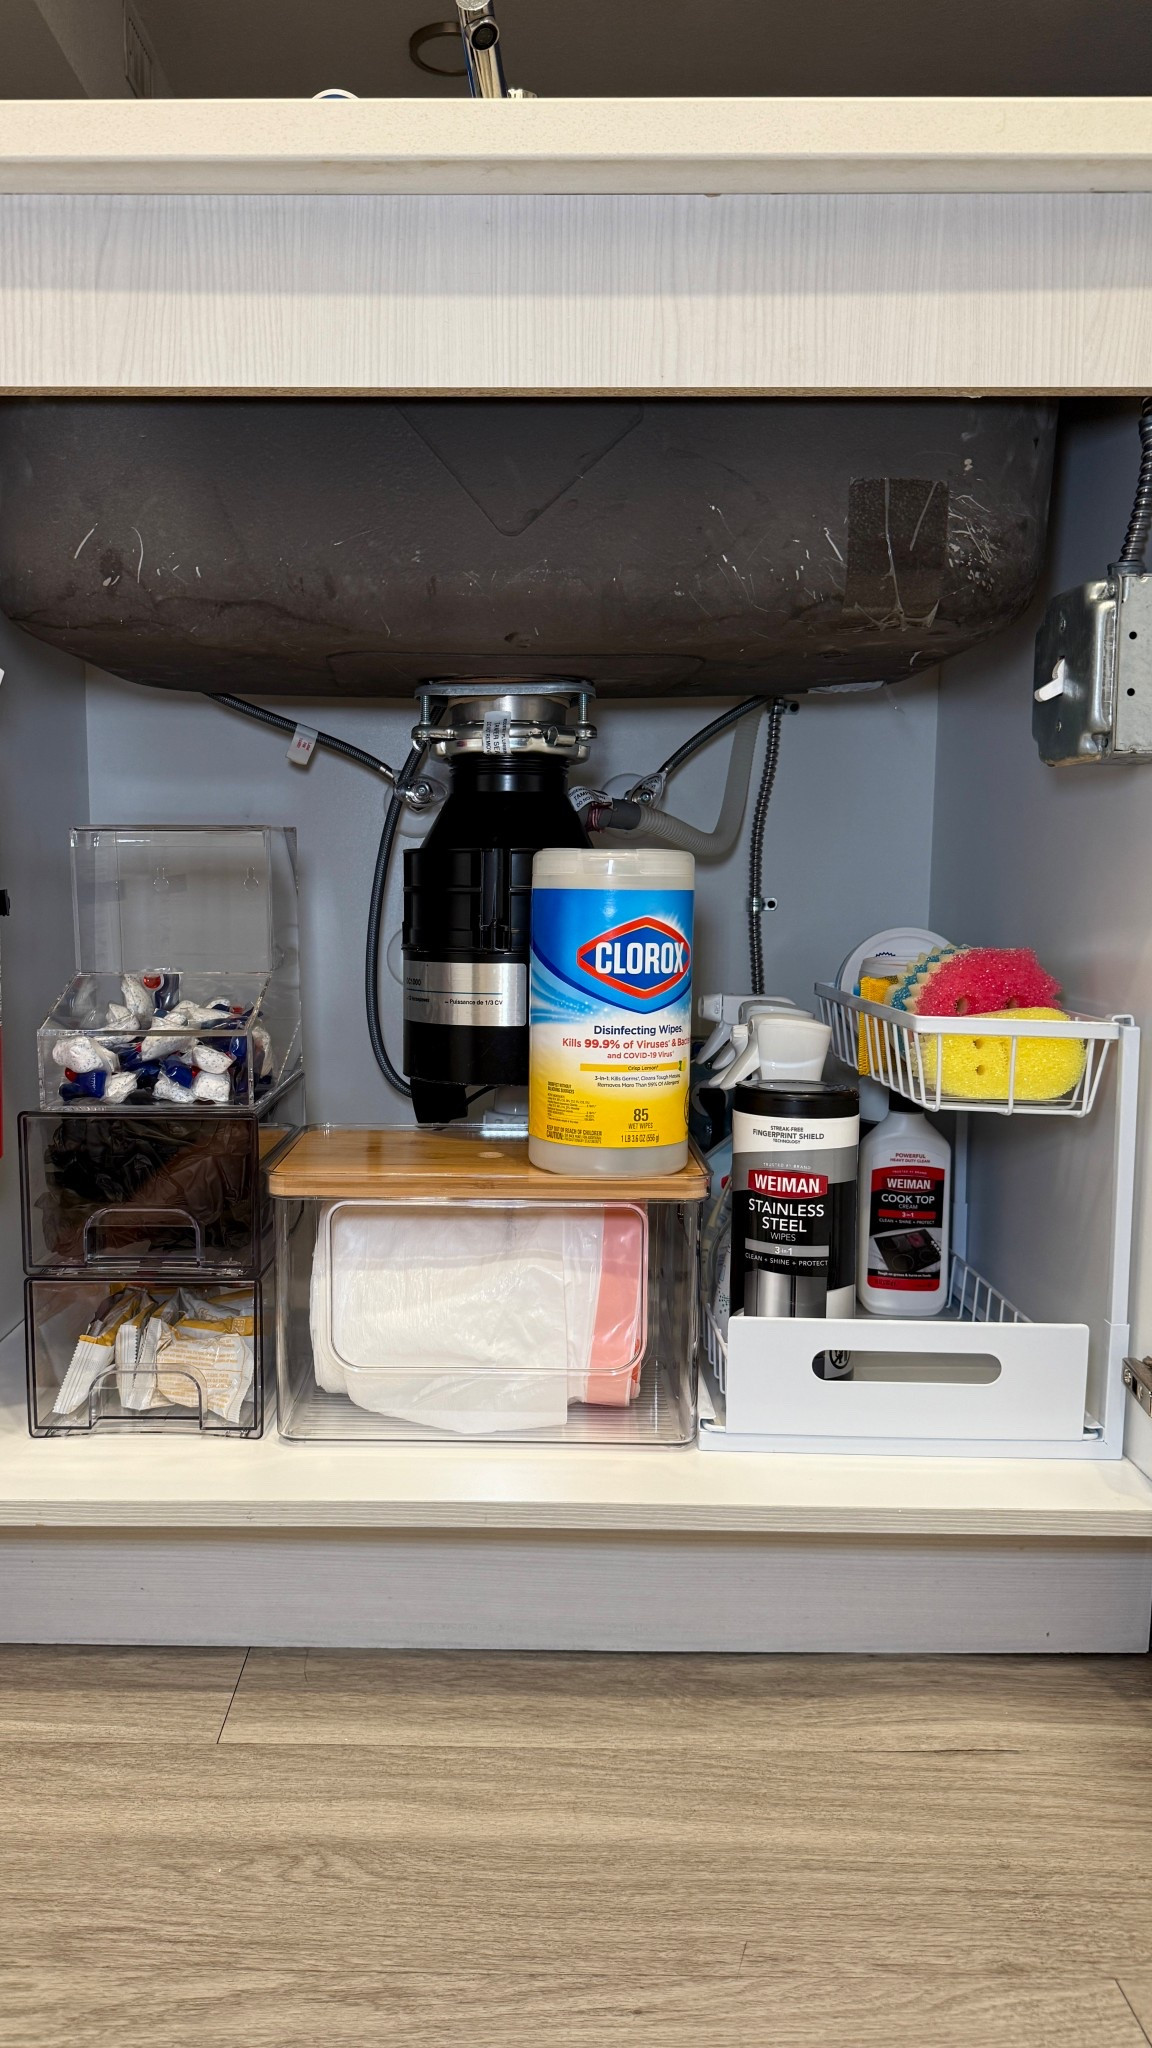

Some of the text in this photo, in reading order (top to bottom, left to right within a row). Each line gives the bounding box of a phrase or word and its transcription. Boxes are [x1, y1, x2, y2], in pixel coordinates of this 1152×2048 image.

[595, 942, 684, 974] CLOROX
[594, 1025, 656, 1036] Disinfecting
[562, 1038, 582, 1048] Kills
[584, 1039, 620, 1049] 99.9%
[623, 1040, 634, 1049] of
[671, 1039, 677, 1047] &
[633, 1108, 649, 1122] 85
[628, 1122, 639, 1130] WET
[639, 1134, 646, 1142] OZ
[752, 1129, 798, 1140] FINGERPRINT
[754, 1173, 820, 1194] WEIMAN
[886, 1177, 931, 1190] WEIMAN
[881, 1193, 935, 1204] COOK TOP
[748, 1197, 825, 1217] STAINLESS
[762, 1216, 807, 1233] STEEL
[770, 1232, 797, 1242] WIPES
[745, 1252, 763, 1261] CLEAN
[769, 1257, 790, 1265] SHINE
